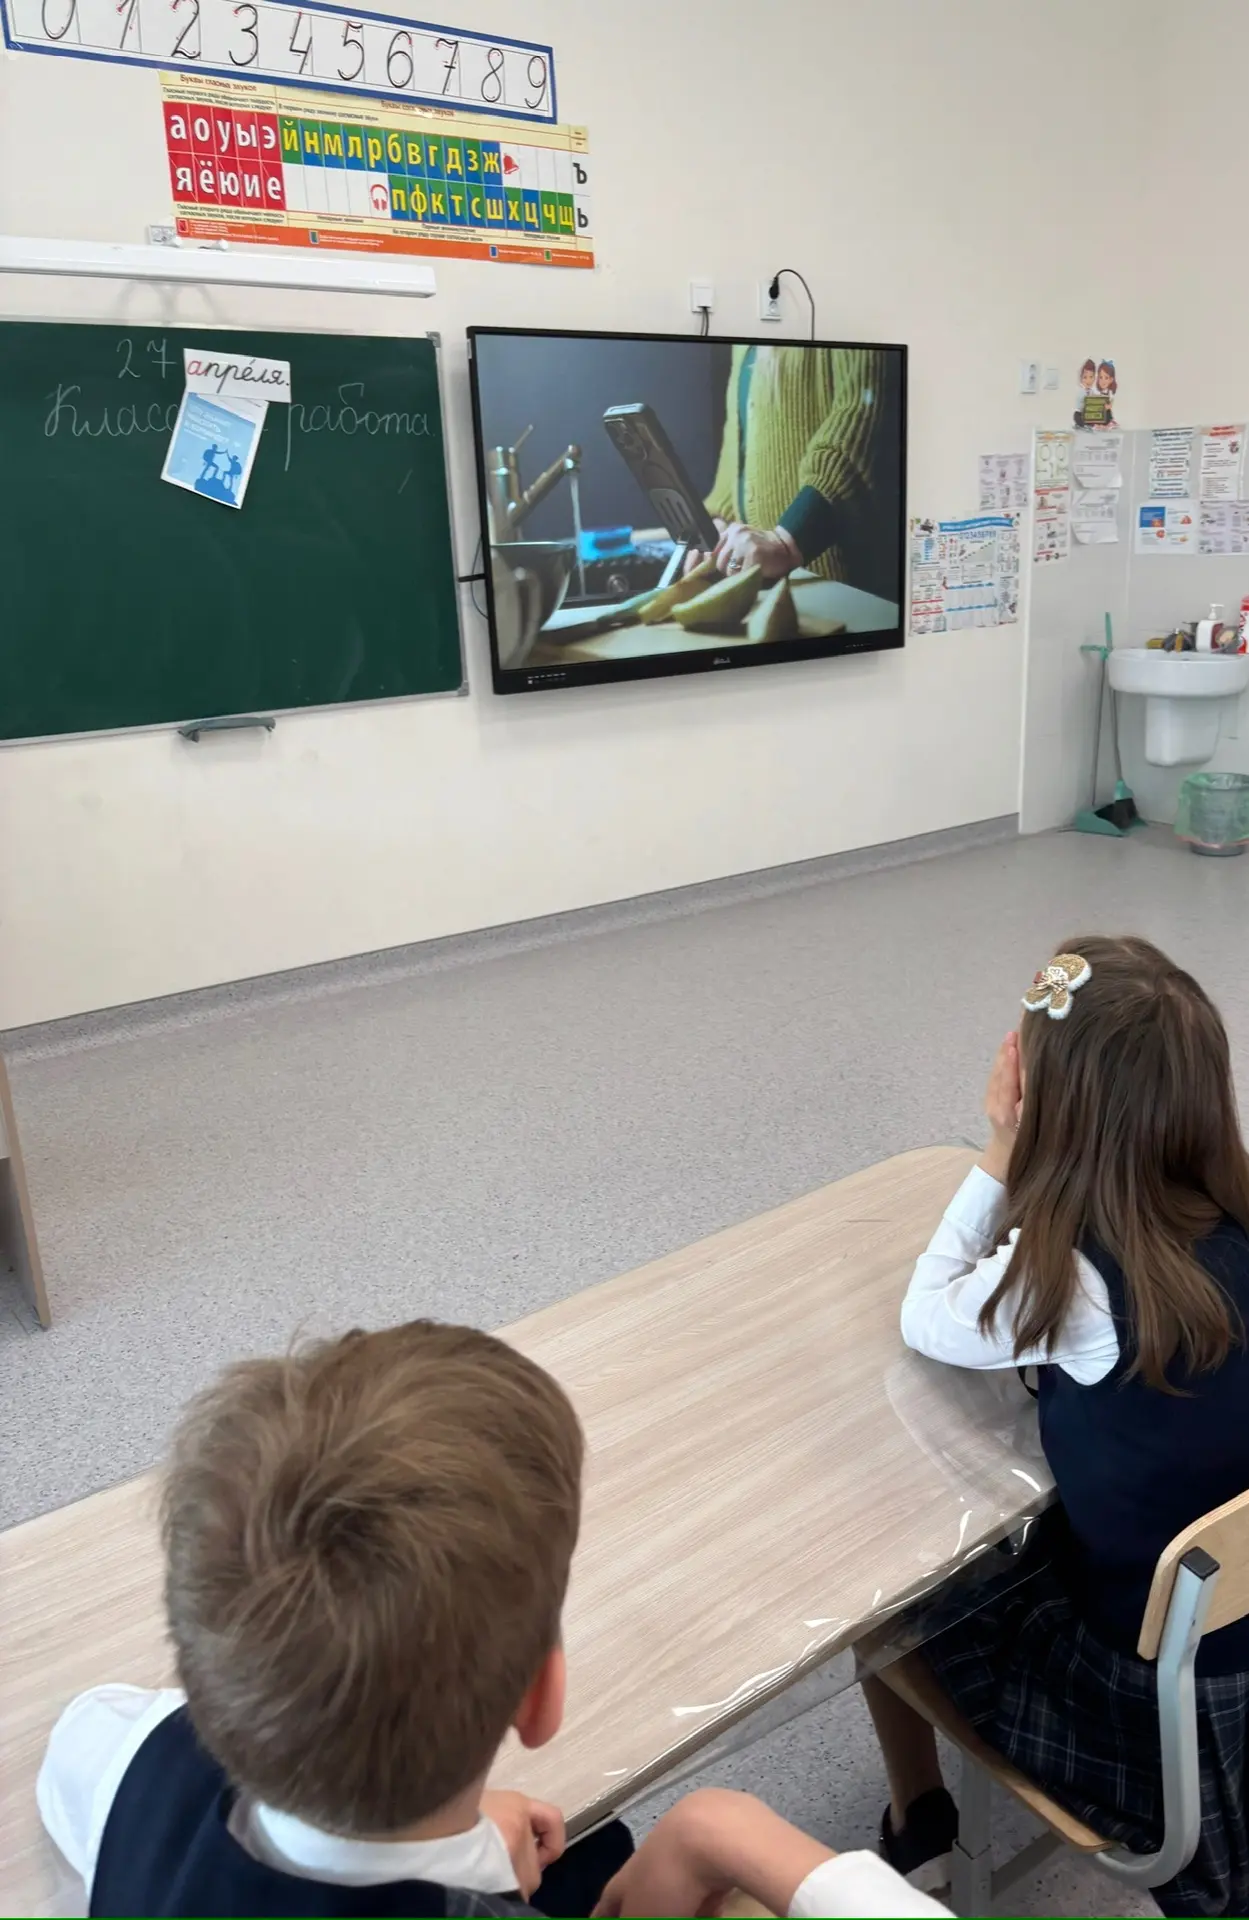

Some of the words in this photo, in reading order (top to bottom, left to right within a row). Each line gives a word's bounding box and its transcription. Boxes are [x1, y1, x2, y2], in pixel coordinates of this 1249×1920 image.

[42, 0, 76, 40] 0
[117, 0, 137, 49] 1
[171, 0, 201, 59] 2
[229, 4, 259, 66] 3
[289, 11, 312, 75] 4
[337, 21, 364, 81] 5
[388, 31, 413, 88] 6
[436, 38, 459, 95] 7
[481, 48, 504, 103] 8
[525, 56, 547, 109] 9
[171, 115, 187, 140] а
[194, 118, 210, 141] о
[217, 120, 231, 152] у
[236, 123, 258, 147] ы
[262, 125, 276, 149] э
[283, 119, 299, 151] й
[305, 129, 319, 154] н
[324, 132, 344, 157] м
[347, 134, 362, 158] л
[367, 137, 381, 168] р
[387, 133, 401, 163] б
[407, 142, 422, 165] в
[428, 145, 438, 167] г
[445, 148, 462, 175] д
[467, 150, 479, 172] з
[483, 151, 501, 173] ж
[572, 162, 587, 184] ъ
[175, 167, 193, 192] я
[200, 161, 215, 194] ё
[220, 171, 240, 196] ю
[244, 173, 260, 198] и
[267, 176, 282, 200] е
[392, 189, 407, 211] п
[410, 184, 427, 221] ф
[432, 193, 444, 215] к
[451, 195, 463, 216] т
[471, 198, 481, 218] с
[486, 198, 504, 220] ш
[508, 201, 520, 221] х
[525, 202, 539, 228] ц
[543, 204, 555, 225] ч
[559, 205, 574, 230] щ
[577, 207, 589, 228] ь
[117, 338, 177, 379] 27
[44, 383, 268, 437] Класс
